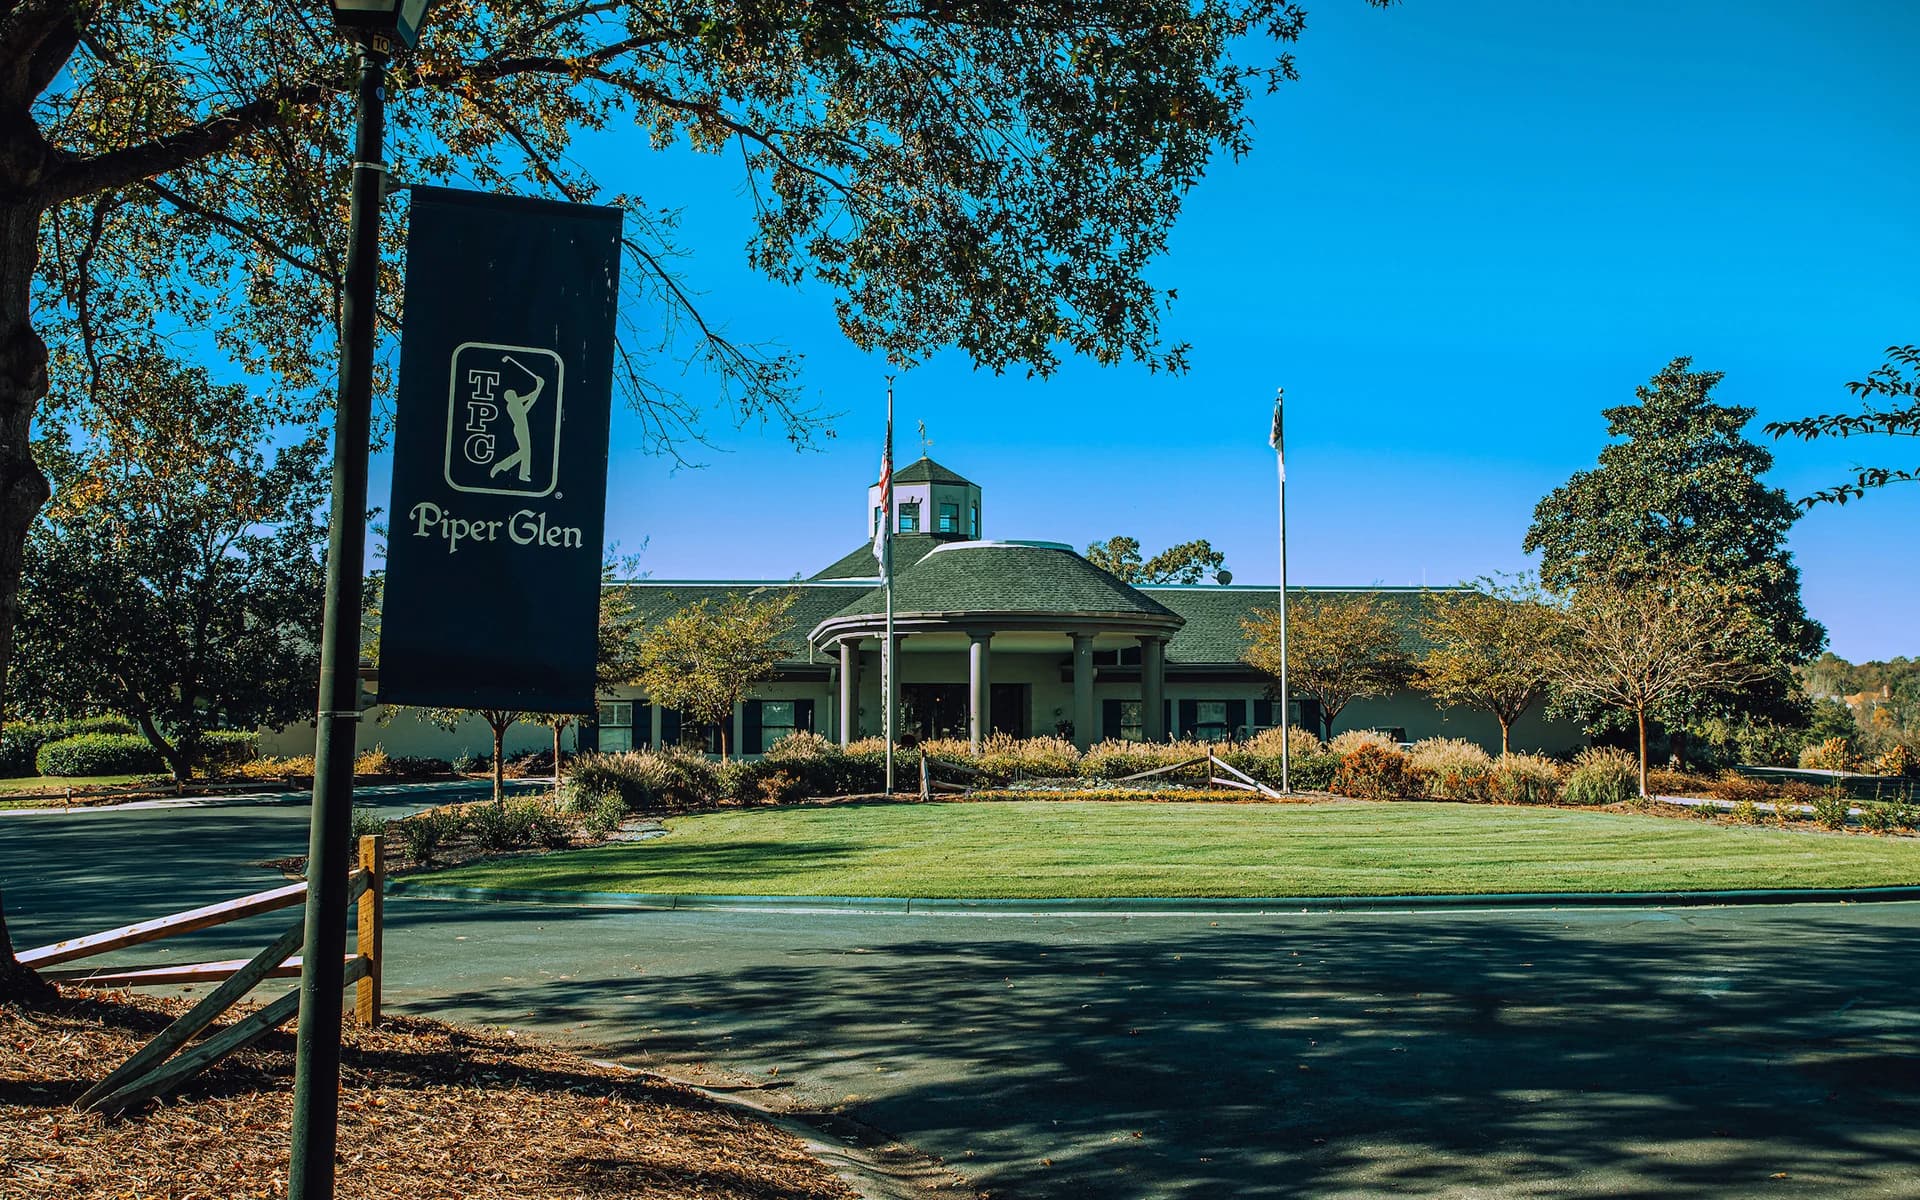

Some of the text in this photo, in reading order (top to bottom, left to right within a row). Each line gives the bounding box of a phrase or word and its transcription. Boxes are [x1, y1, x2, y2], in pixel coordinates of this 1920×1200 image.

[375, 38, 389, 51] 10
[464, 369, 500, 465] TPC
[409, 502, 583, 554] Piper Glen
